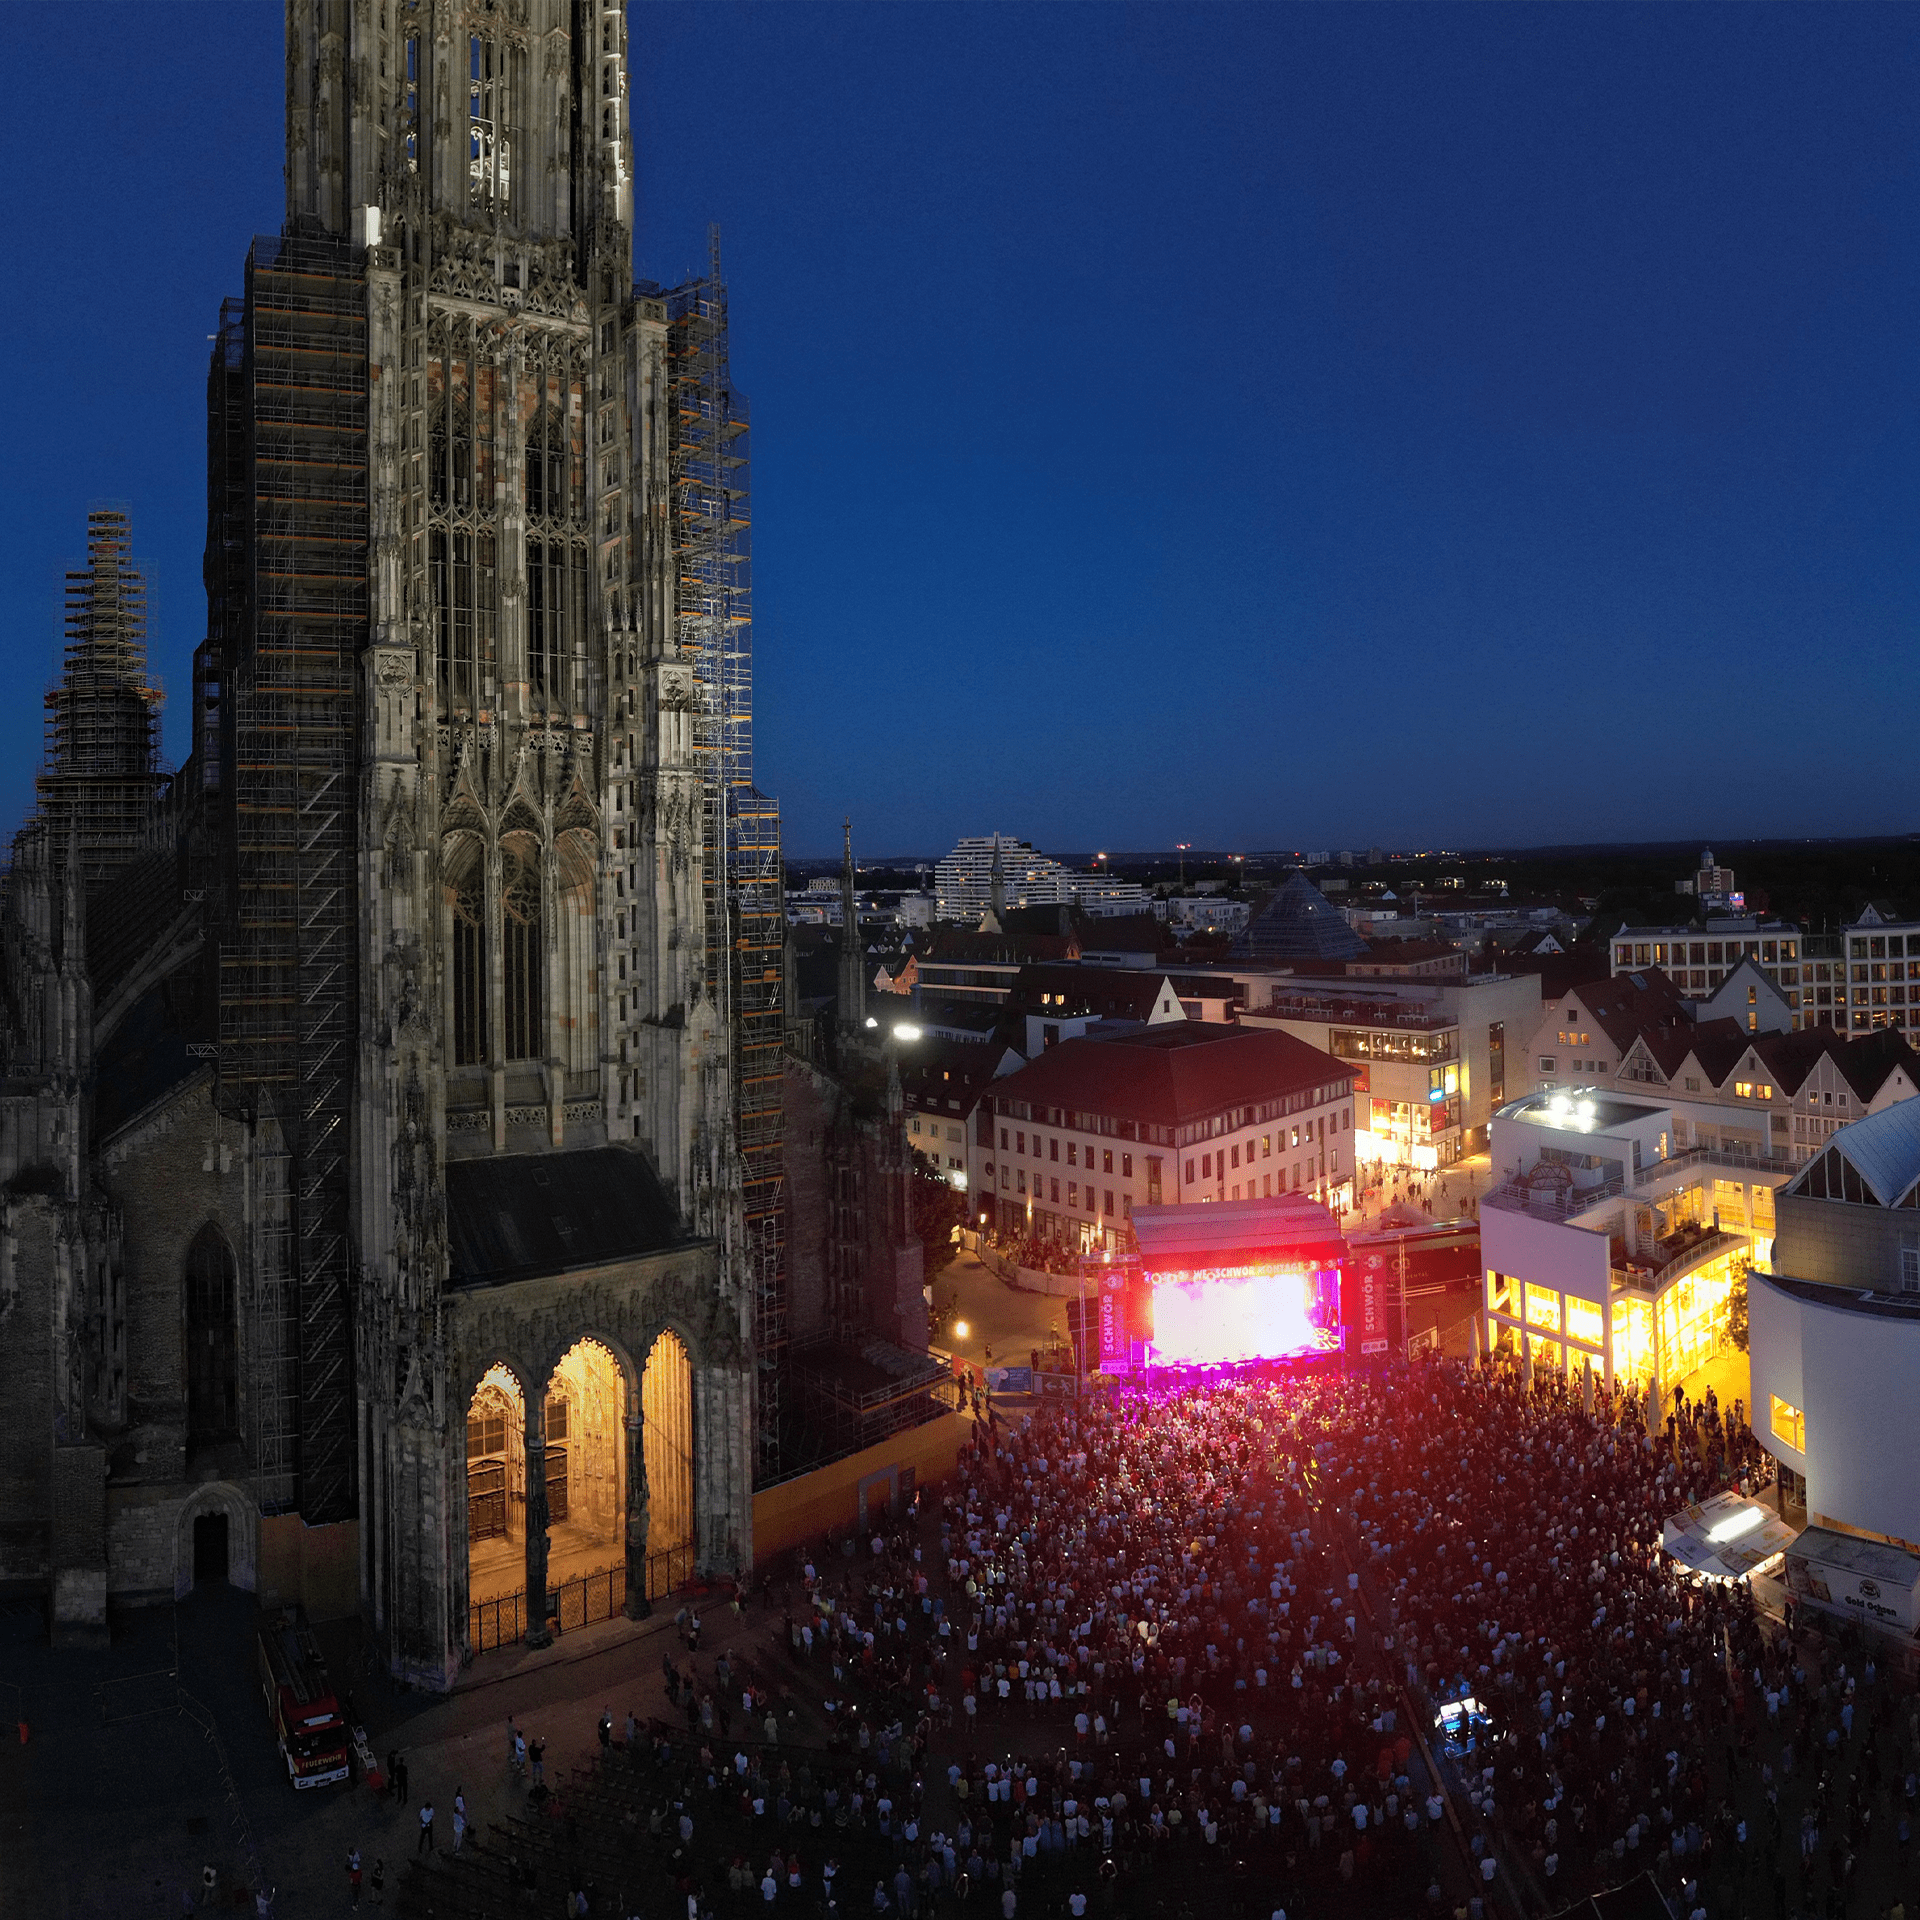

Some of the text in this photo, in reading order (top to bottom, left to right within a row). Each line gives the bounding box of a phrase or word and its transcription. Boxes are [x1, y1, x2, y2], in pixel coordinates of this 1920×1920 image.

[1100, 1294, 1114, 1352] SCHWÖR
[1844, 1595, 1865, 1608] Gold
[1867, 1601, 1897, 1617] Ochsen
[301, 1753, 342, 1769] FEUERWEHR
